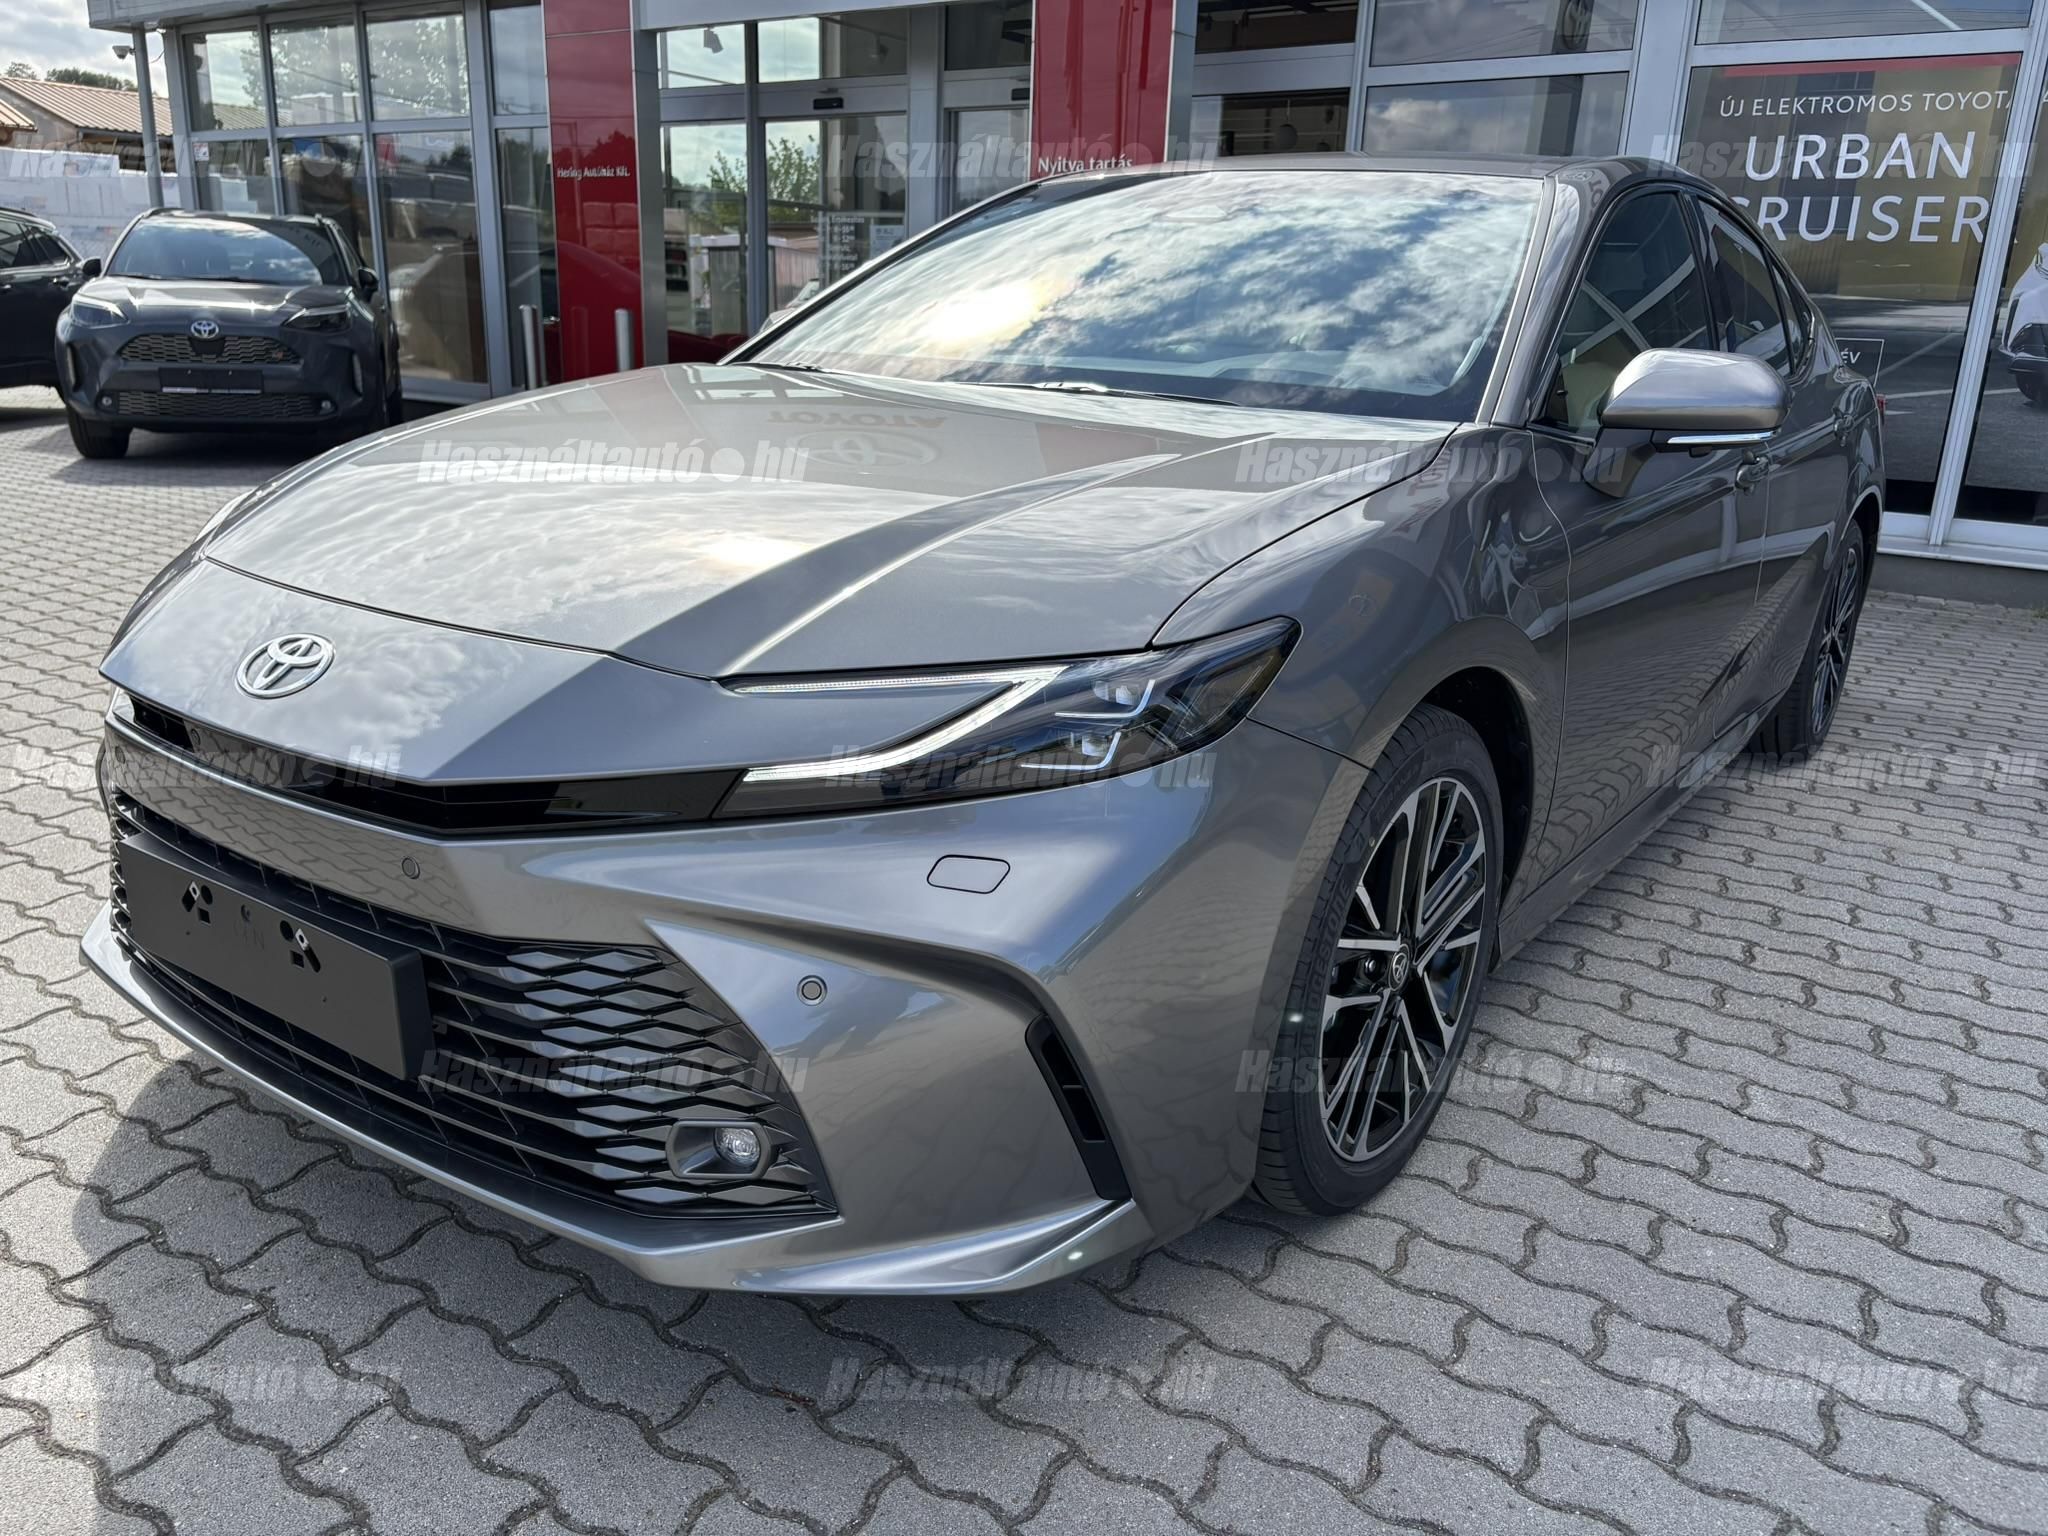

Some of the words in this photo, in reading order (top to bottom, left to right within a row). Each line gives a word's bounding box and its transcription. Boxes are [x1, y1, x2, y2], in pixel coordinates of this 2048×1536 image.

[1720, 96, 1744, 117] ÚJ
[1752, 94, 1912, 116] ELEKTROMOS
[1922, 90, 2011, 112] TOYOT
[1038, 156, 1084, 176] Nyitva
[1089, 153, 1132, 171] tartás
[1745, 130, 1976, 181] URBAN
[1728, 195, 1989, 243] RUISER
